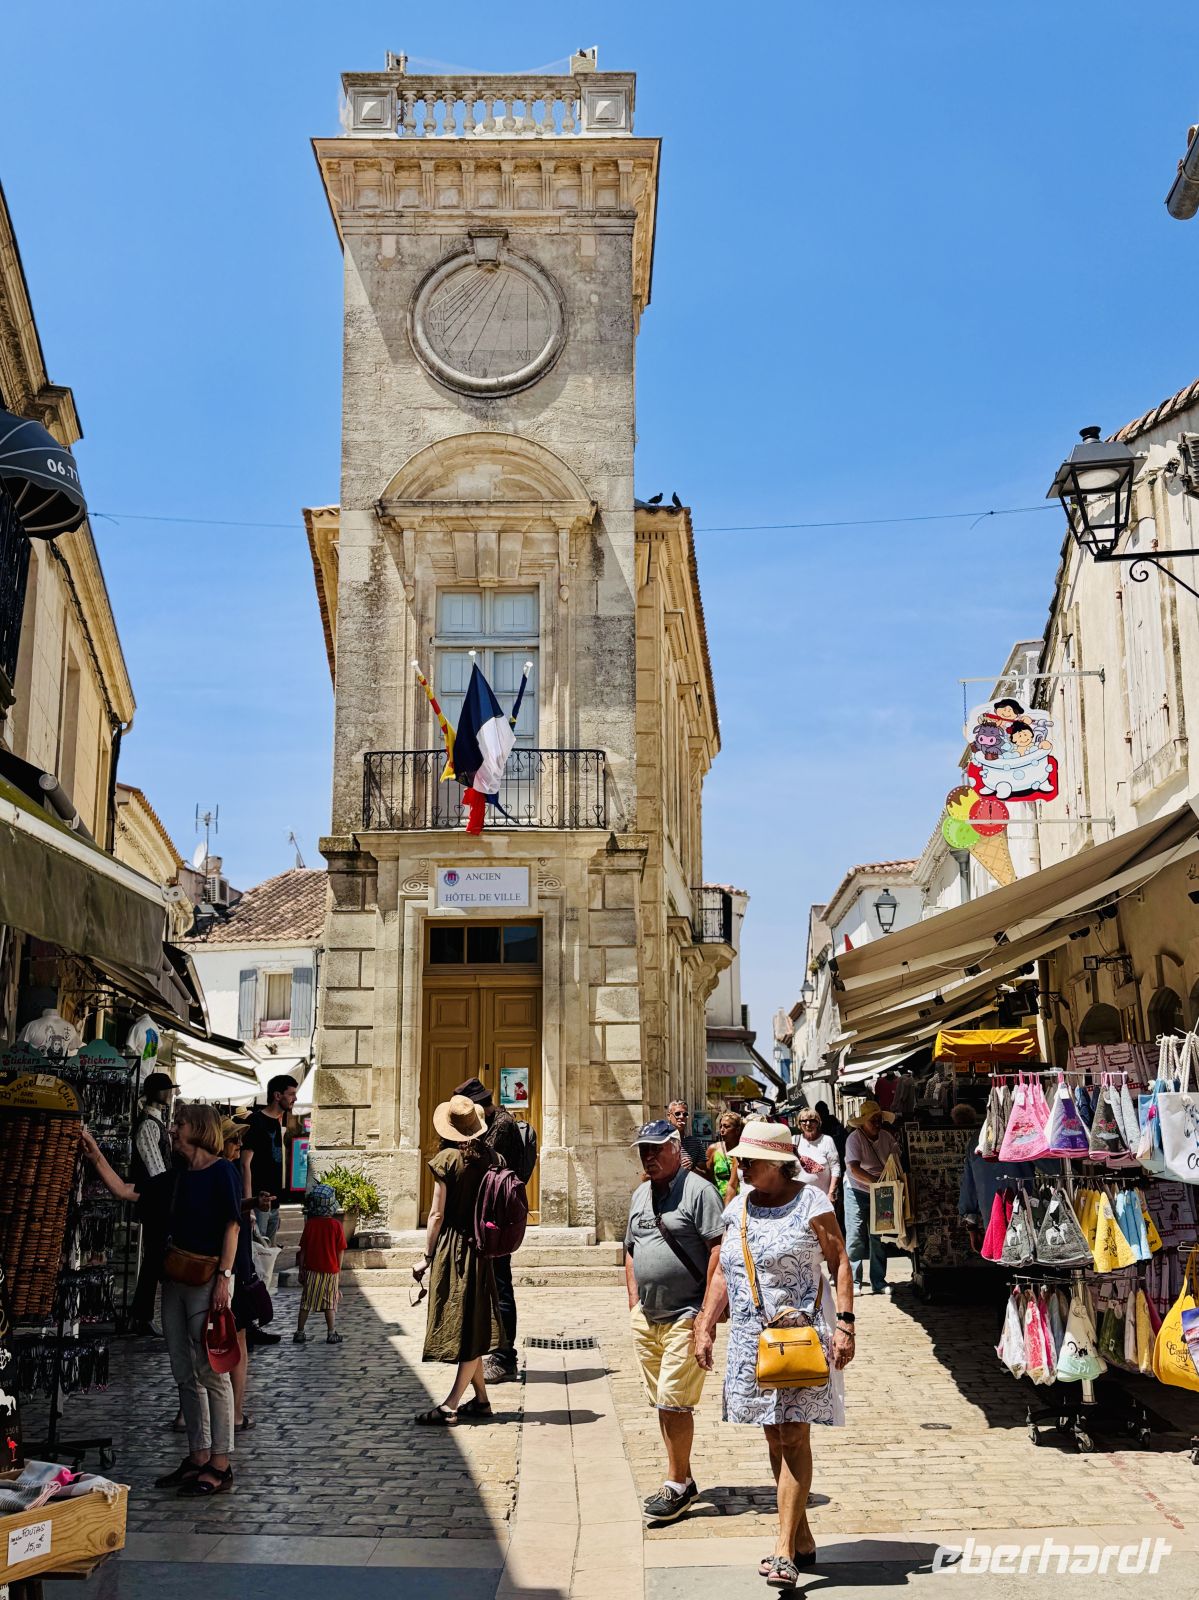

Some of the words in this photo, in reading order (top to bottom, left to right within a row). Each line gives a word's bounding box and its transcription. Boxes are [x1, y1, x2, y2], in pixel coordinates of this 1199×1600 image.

[516, 350, 531, 361] XII
[465, 872, 502, 881] ANCIEN
[445, 892, 476, 902] HÔTEL
[479, 893, 492, 902] DE
[494, 892, 521, 901] VILLE
[79, 1054, 116, 1066] Stickers
[58, 1085, 75, 1107] Cuir
